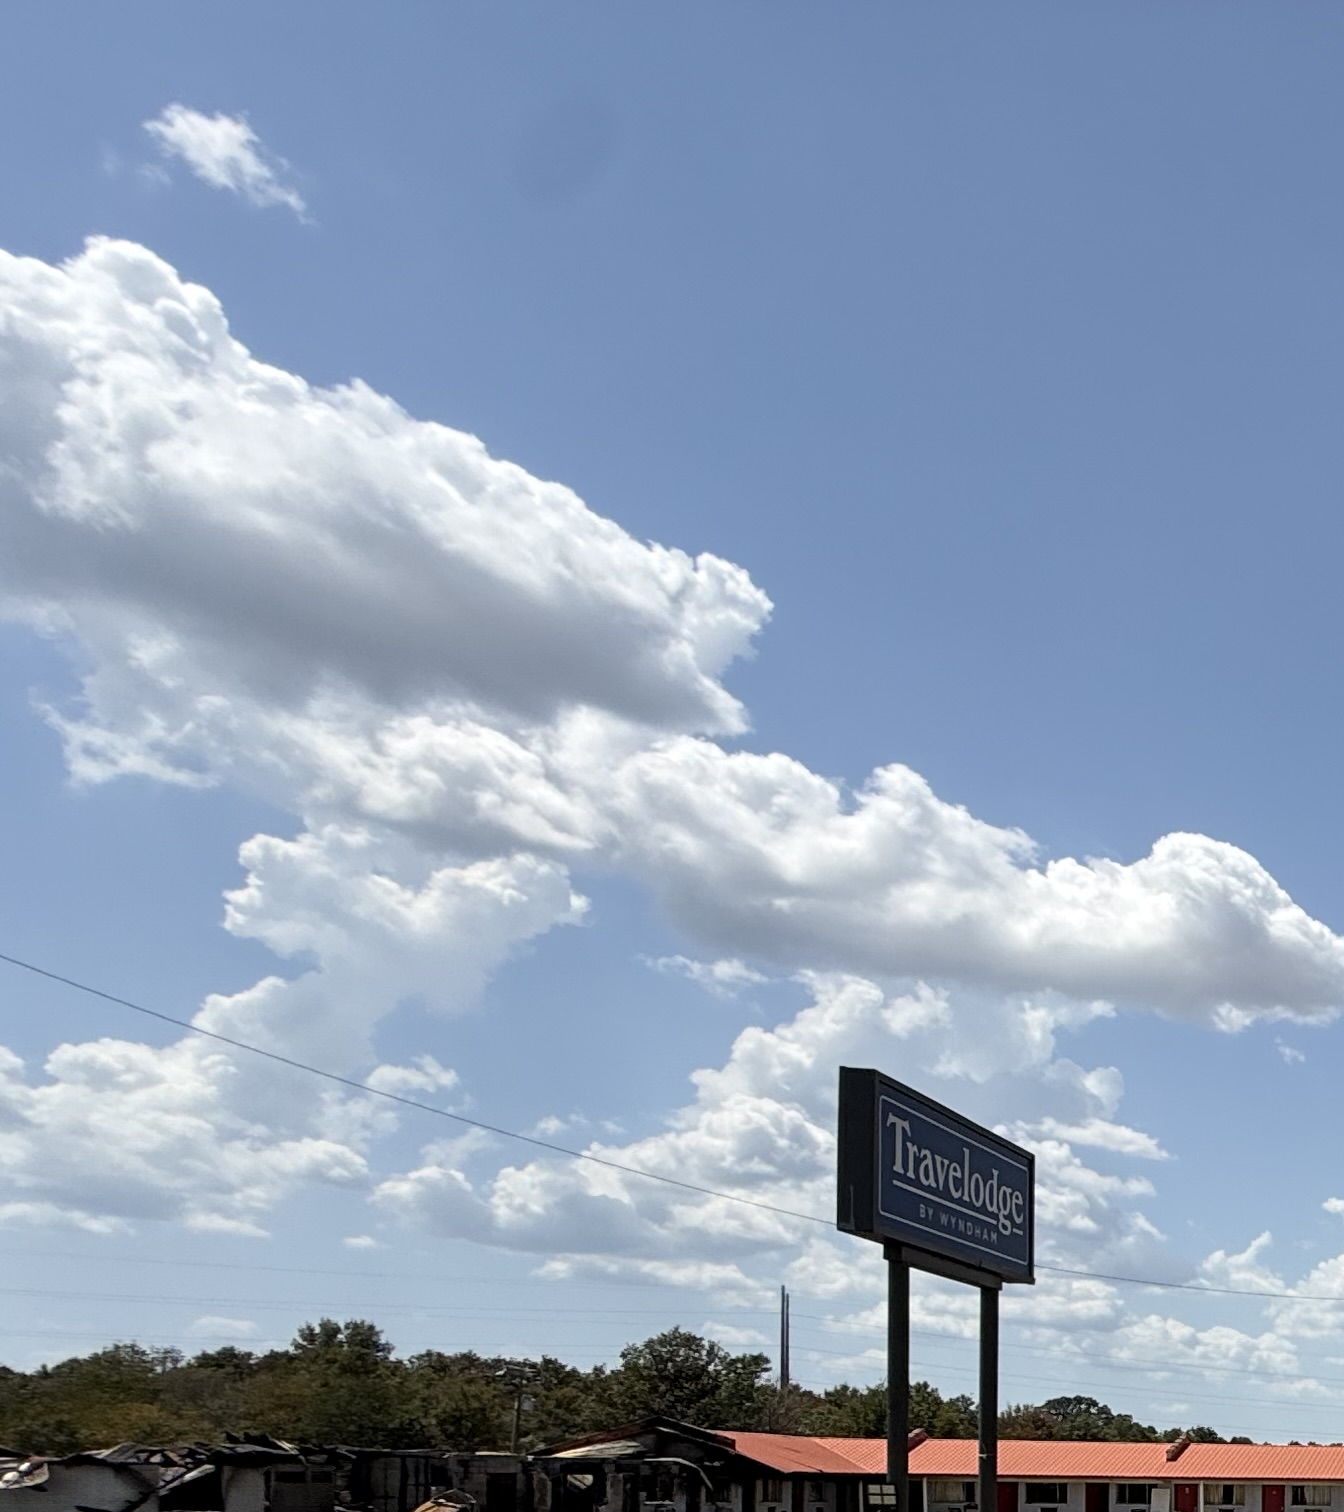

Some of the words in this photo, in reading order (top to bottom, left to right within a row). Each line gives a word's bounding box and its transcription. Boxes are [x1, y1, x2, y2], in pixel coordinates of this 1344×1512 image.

[886, 1112, 1024, 1235] Travelodge
[919, 1203, 934, 1222] BY
[940, 1211, 998, 1245] WYNDHAM
